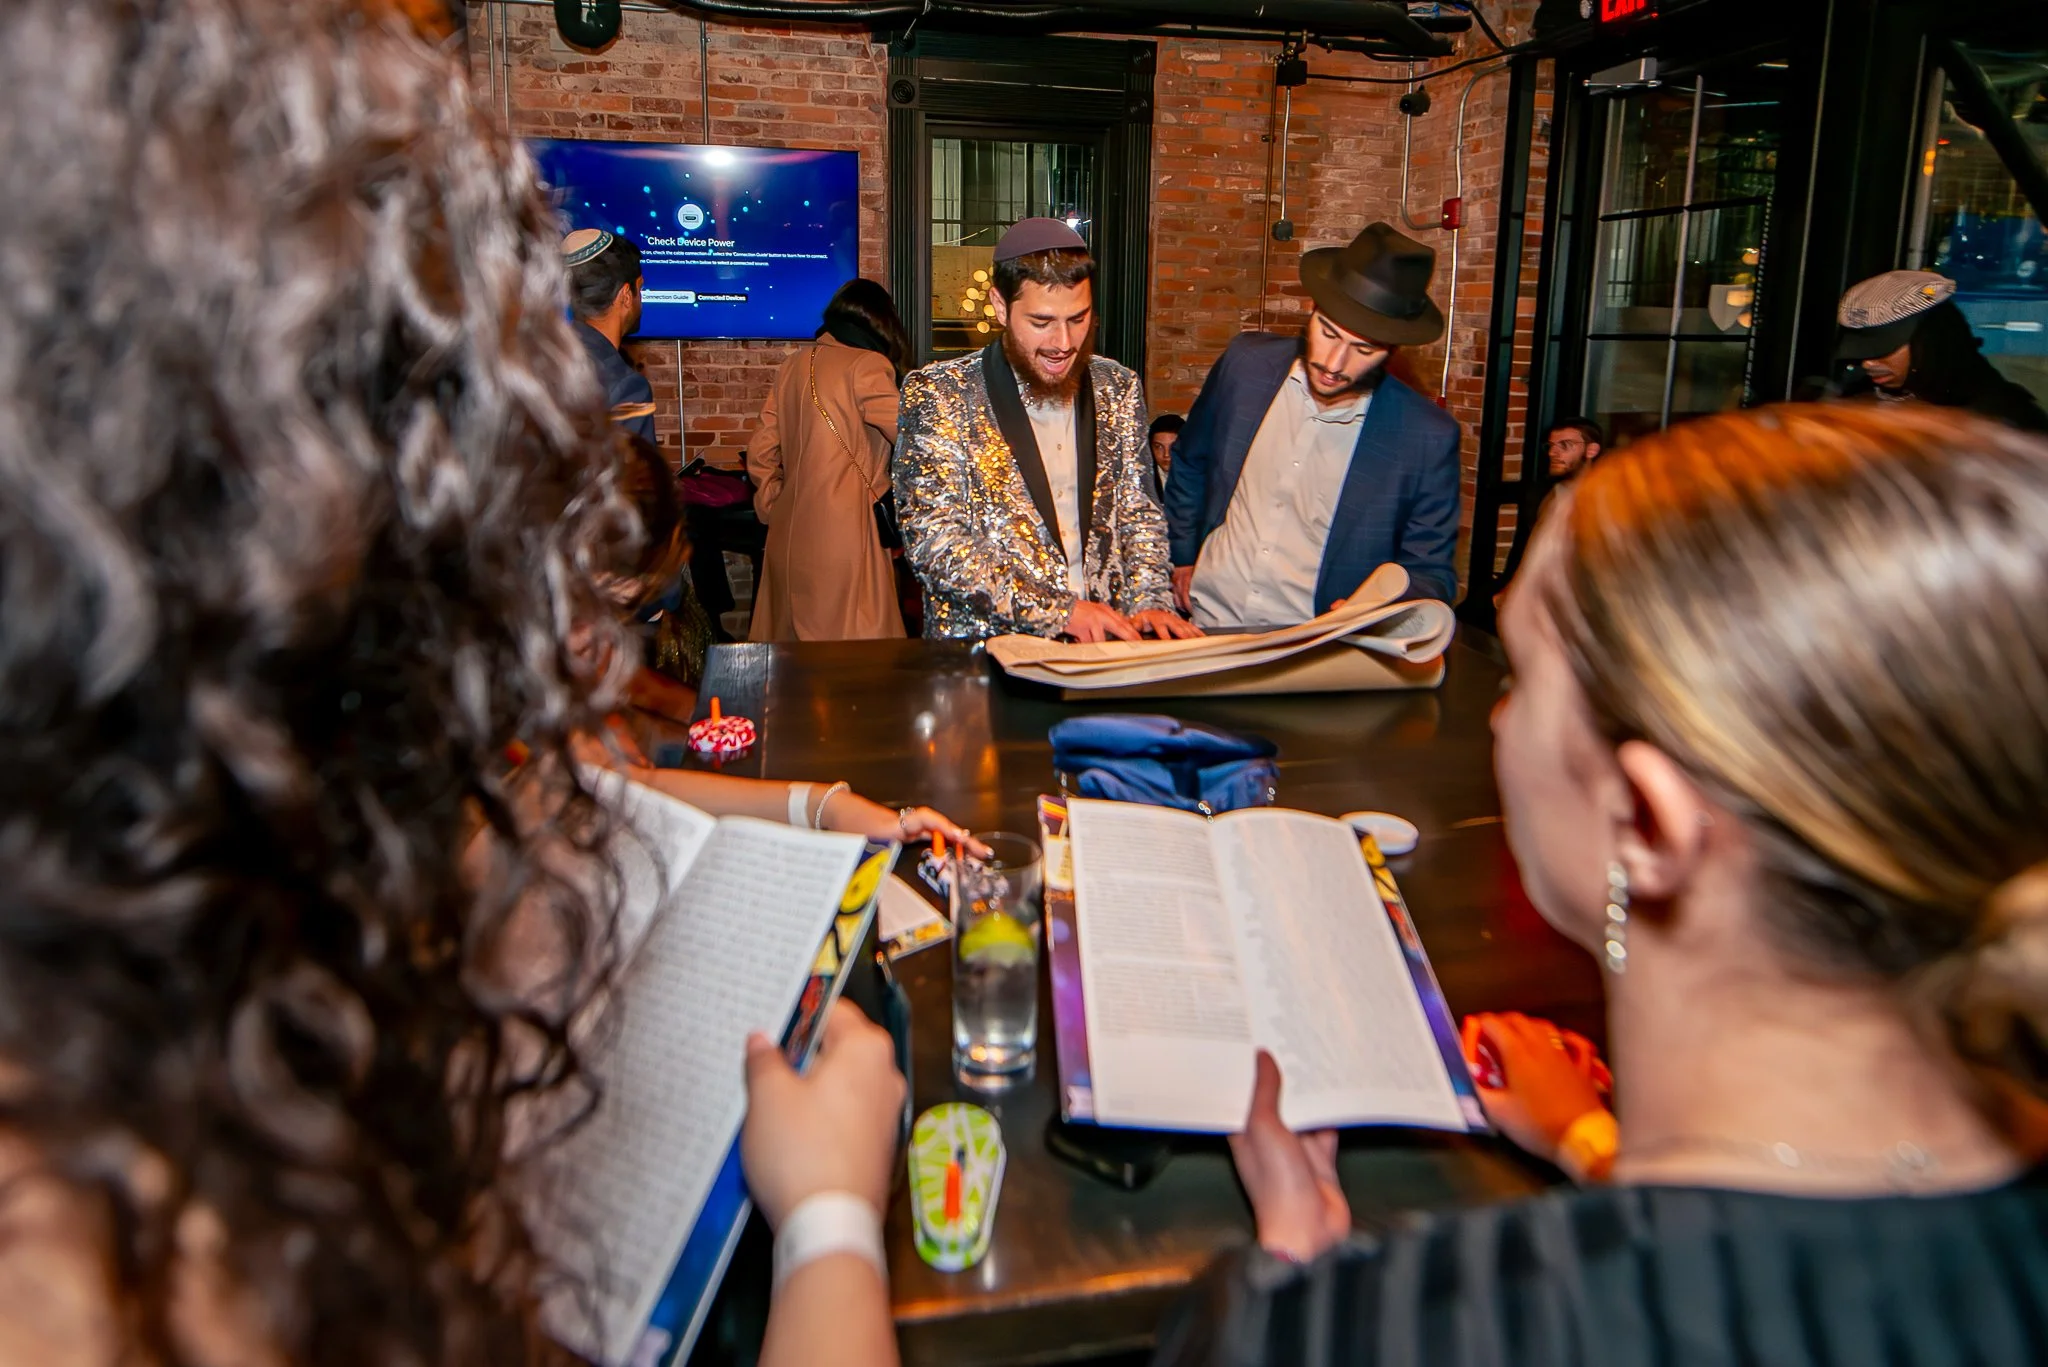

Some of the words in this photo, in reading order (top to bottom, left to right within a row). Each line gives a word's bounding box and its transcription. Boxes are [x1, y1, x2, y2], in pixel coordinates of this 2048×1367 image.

[1601, 0, 1645, 22] EX
[647, 236, 676, 246] Check
[677, 237, 706, 247] Device
[708, 238, 735, 248] Power
